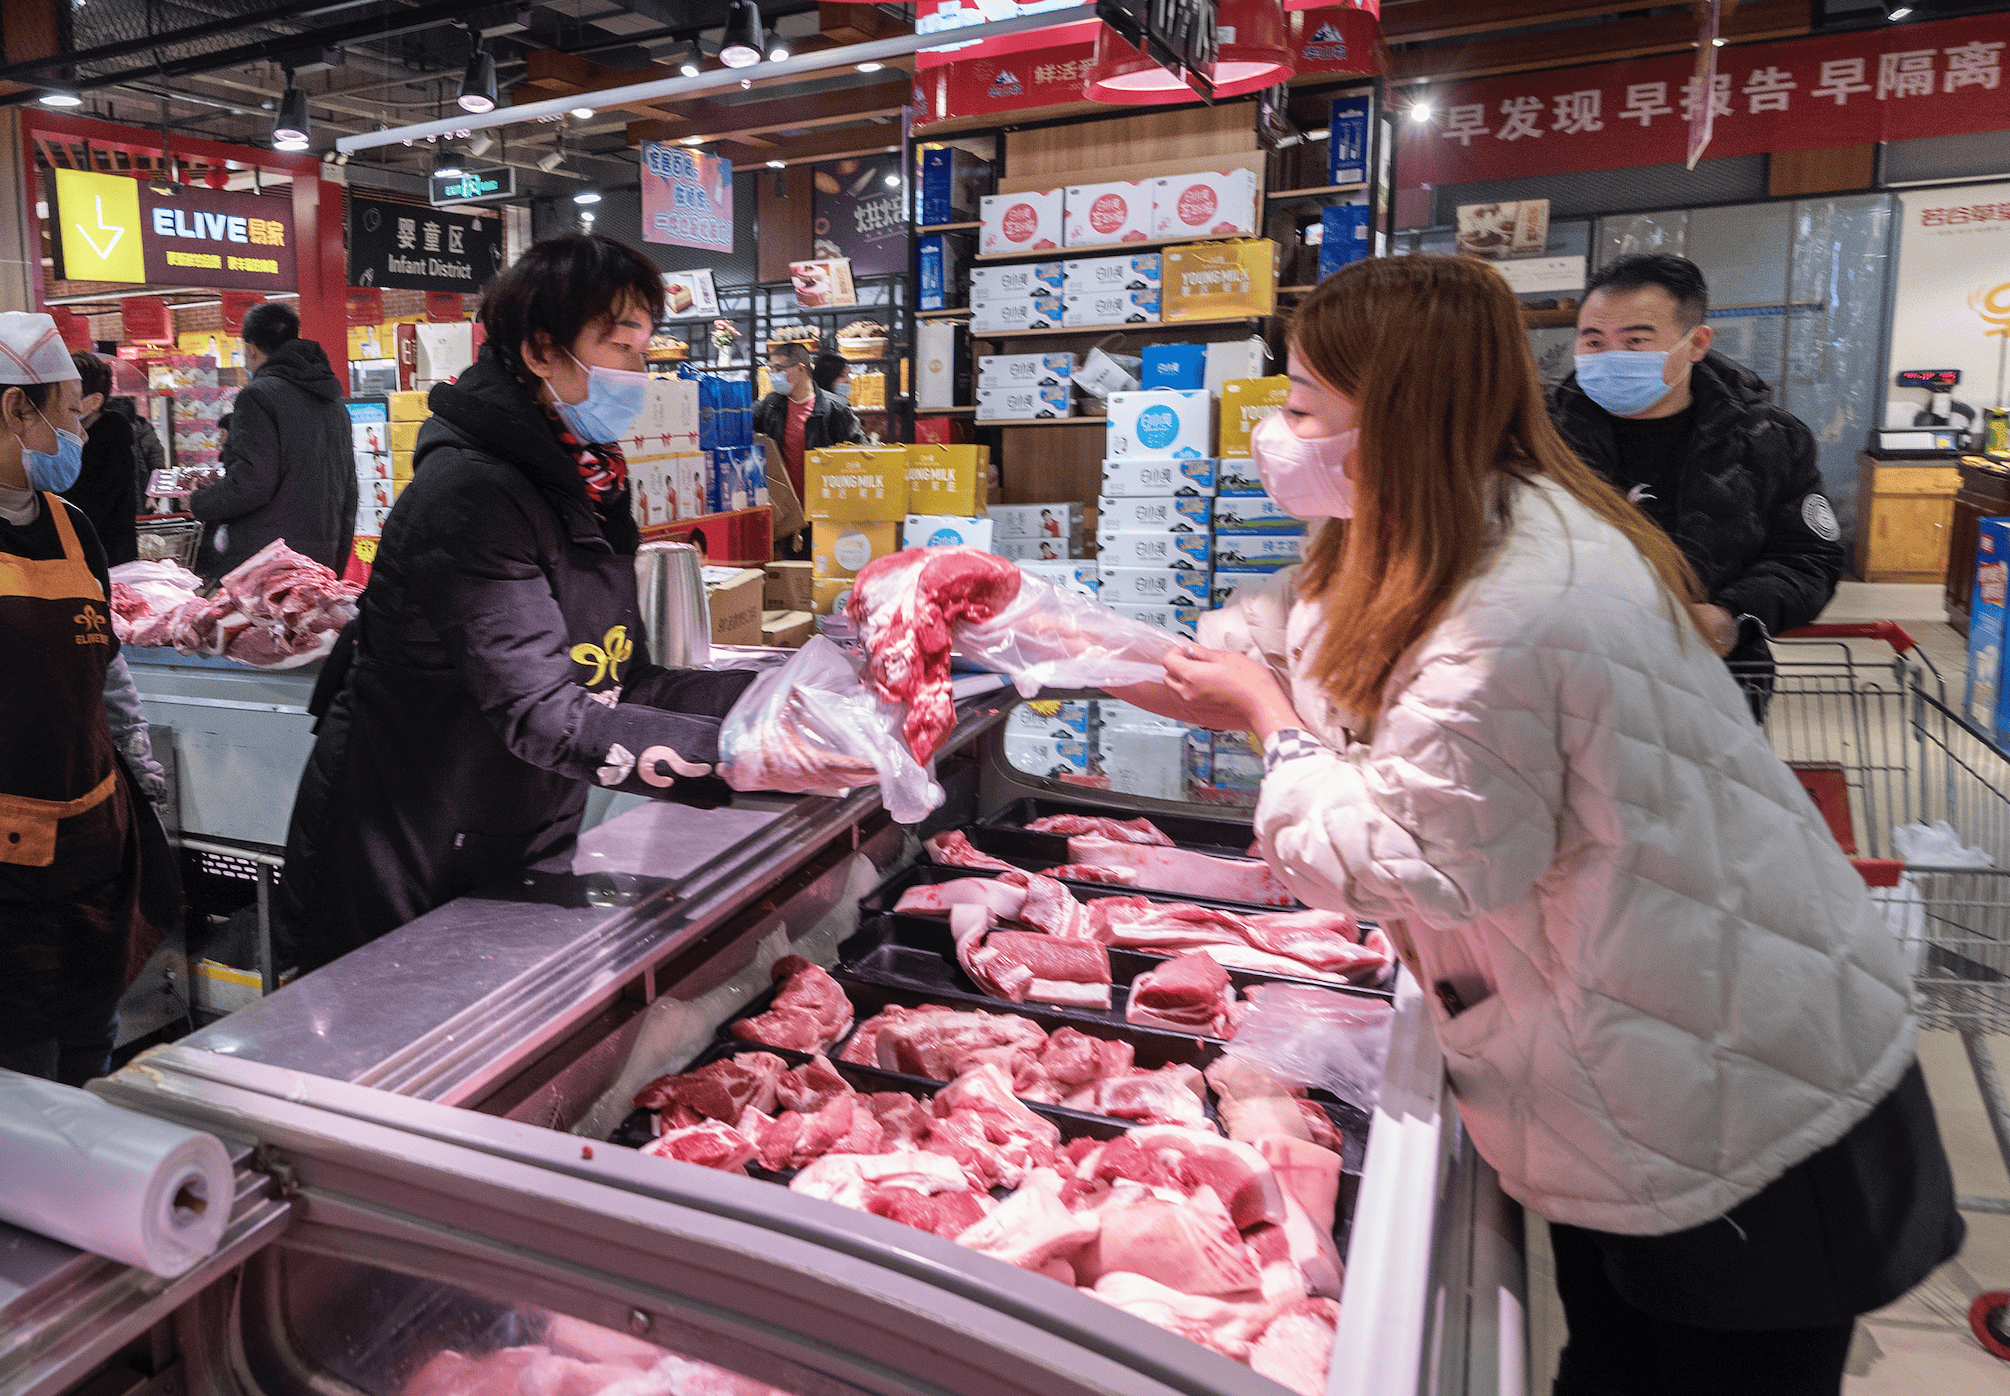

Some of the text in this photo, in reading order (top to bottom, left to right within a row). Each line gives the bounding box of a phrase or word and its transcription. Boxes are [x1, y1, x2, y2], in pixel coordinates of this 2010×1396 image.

[1442, 41, 2007, 146] 早发现 早报告 早隔离
[152, 207, 249, 244] ELIVE
[397, 217, 466, 255] 婴童区
[388, 253, 473, 280] Infant District
[1239, 404, 1283, 421] YOU
